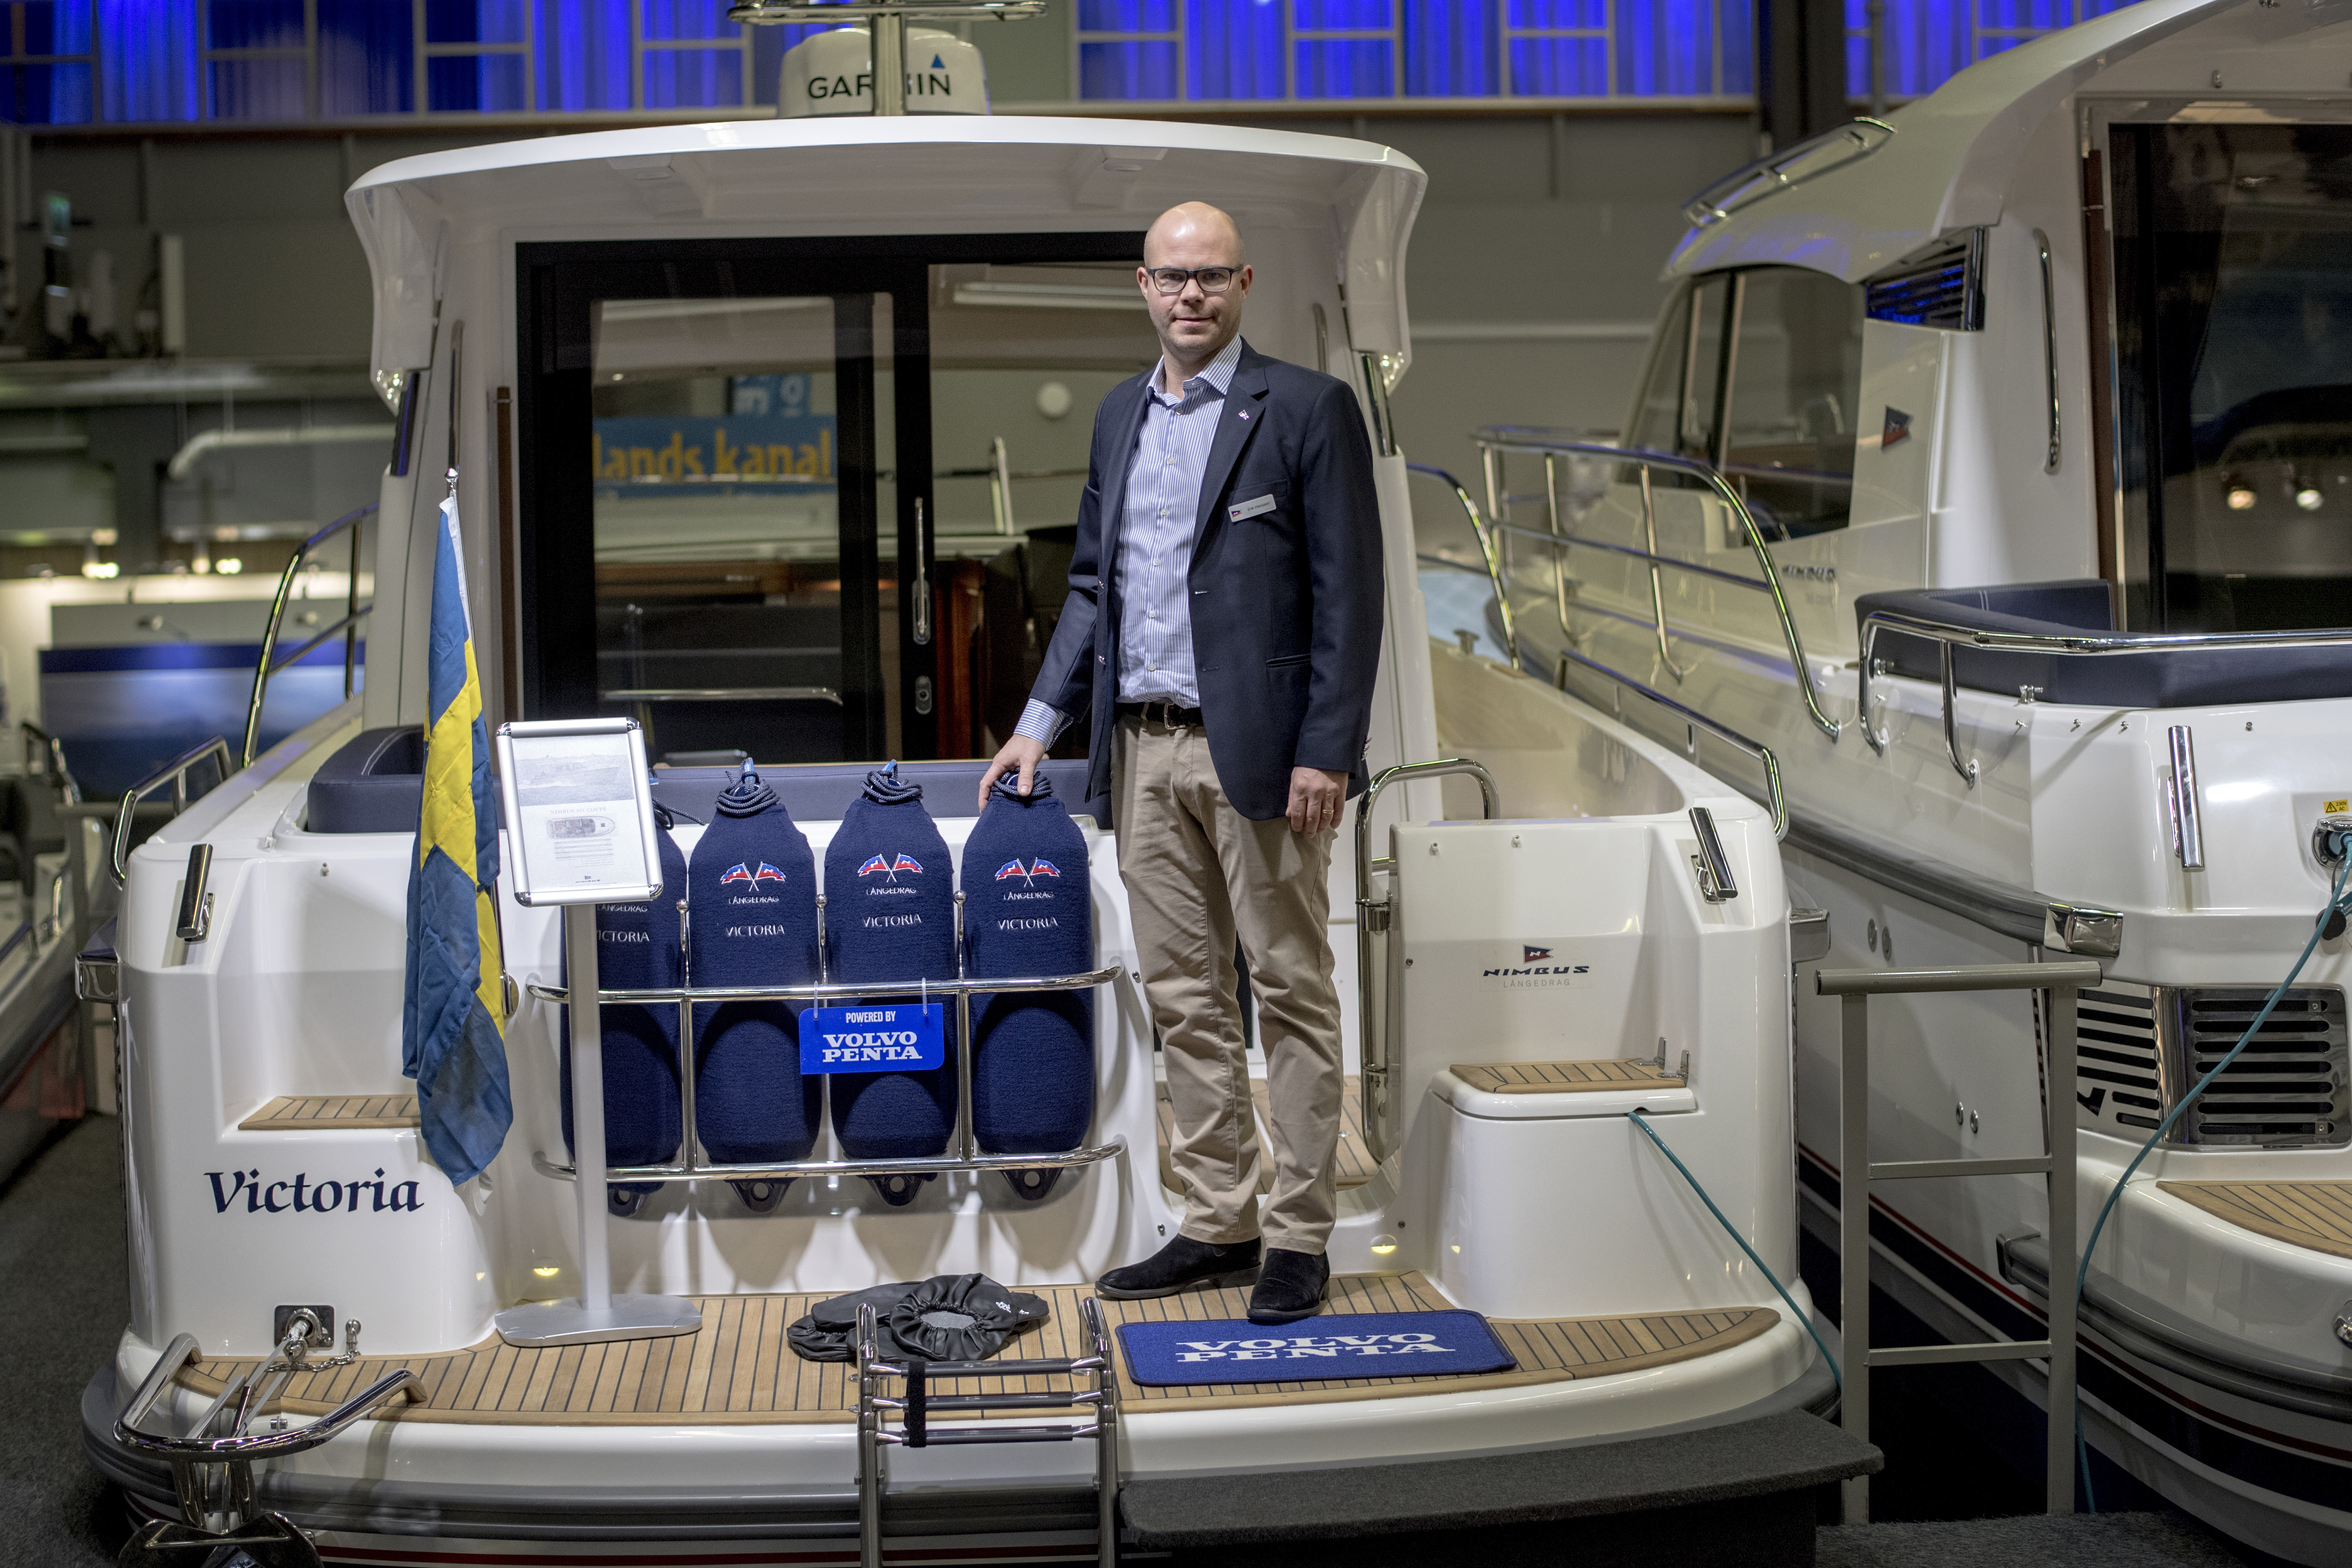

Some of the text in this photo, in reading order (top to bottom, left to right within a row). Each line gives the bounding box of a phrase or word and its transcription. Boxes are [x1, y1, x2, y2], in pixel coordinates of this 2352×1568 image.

[808, 74, 951, 98] GARIN
[715, 428, 832, 476] kanal
[863, 913, 921, 927] VICTORIA
[998, 917, 1058, 929] VICTORIA
[597, 930, 650, 942] ICTORIA
[726, 924, 784, 936] VICTORIA
[1483, 966, 1590, 977] NIMBUS
[1503, 979, 1570, 988] LÅNGEDRAG
[846, 1011, 896, 1023] POWERED BY
[823, 1031, 917, 1047] VOLVO
[822, 1046, 923, 1062] PENTA
[203, 1167, 425, 1213] Victoria
[1176, 1333, 1436, 1351] VOLVO
[1176, 1343, 1456, 1362] PENTA
